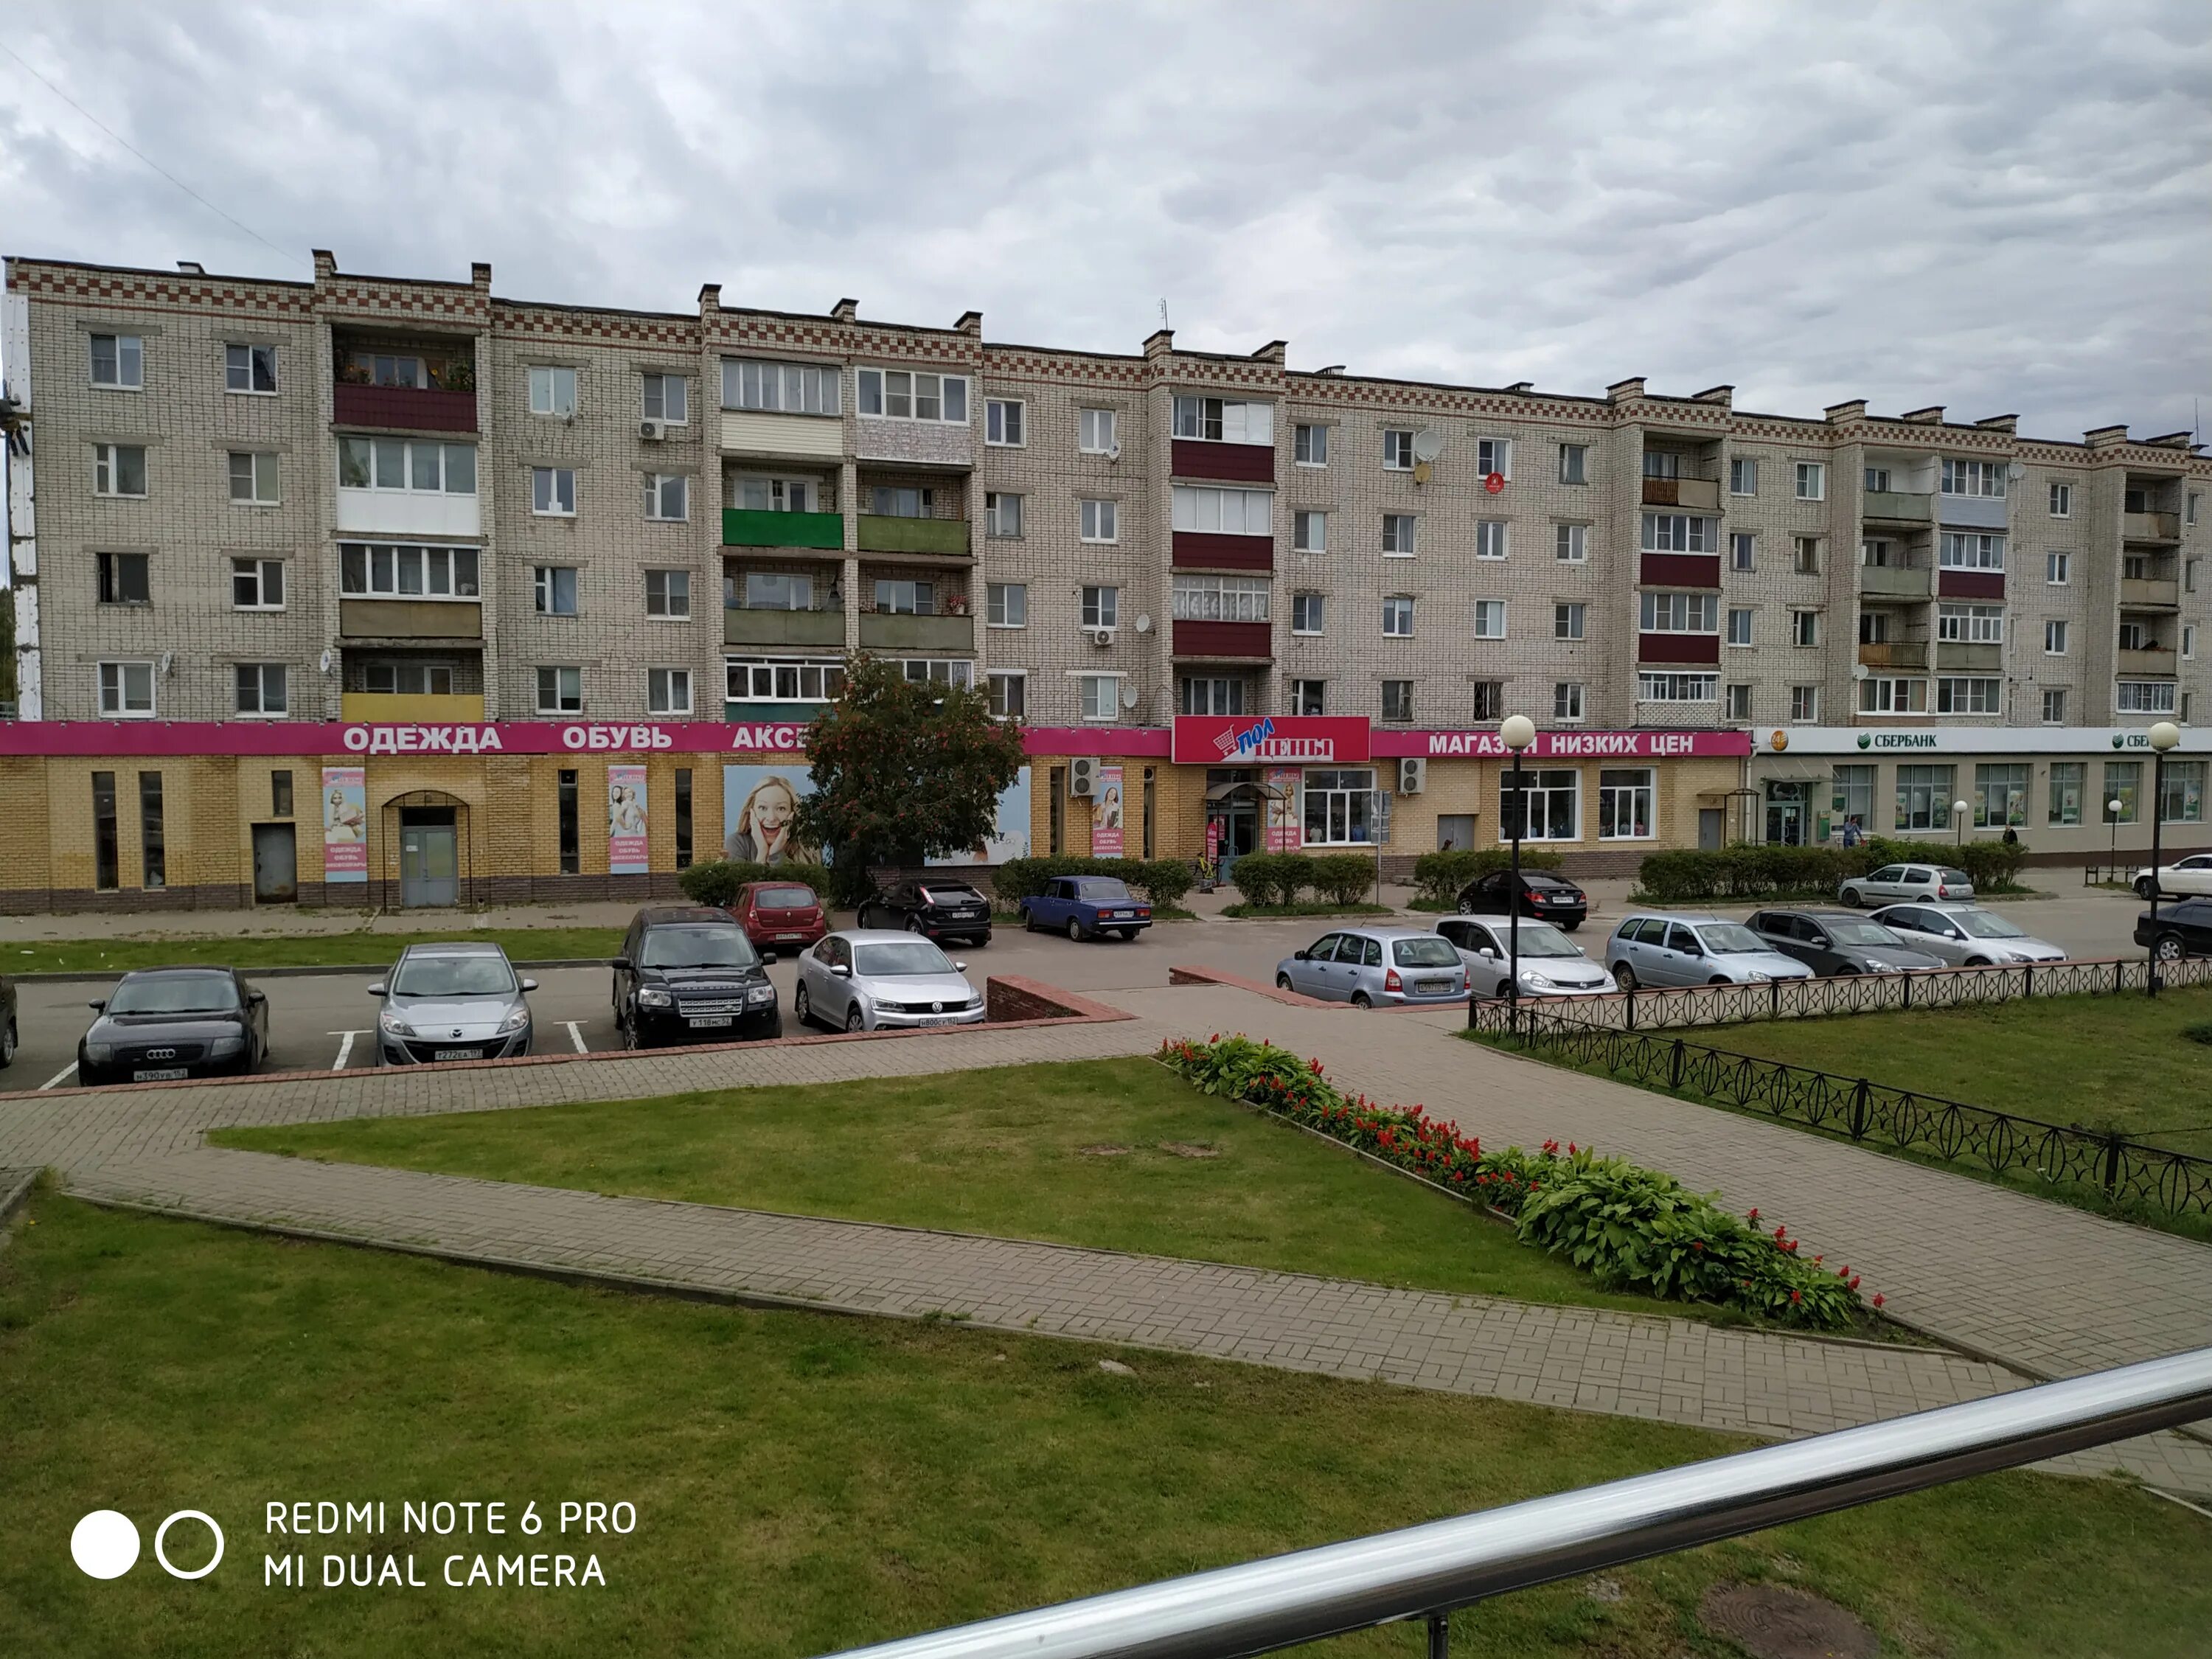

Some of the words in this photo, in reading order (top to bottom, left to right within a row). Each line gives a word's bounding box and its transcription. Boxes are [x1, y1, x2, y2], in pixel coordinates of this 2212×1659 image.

[344, 727, 503, 754] ОДЕЖДА
[563, 726, 672, 748] ОБУВЬ
[733, 727, 810, 748] АКСЕ
[1237, 717, 1275, 755] ПОЛ
[1429, 735, 1537, 754] МАГАЗН
[1551, 735, 1638, 754] НИЗКИХ
[1651, 735, 1693, 756] ЦЕН
[1875, 734, 1937, 748] СБЕРБАНК
[1255, 738, 1335, 762] ЦЕНЫ
